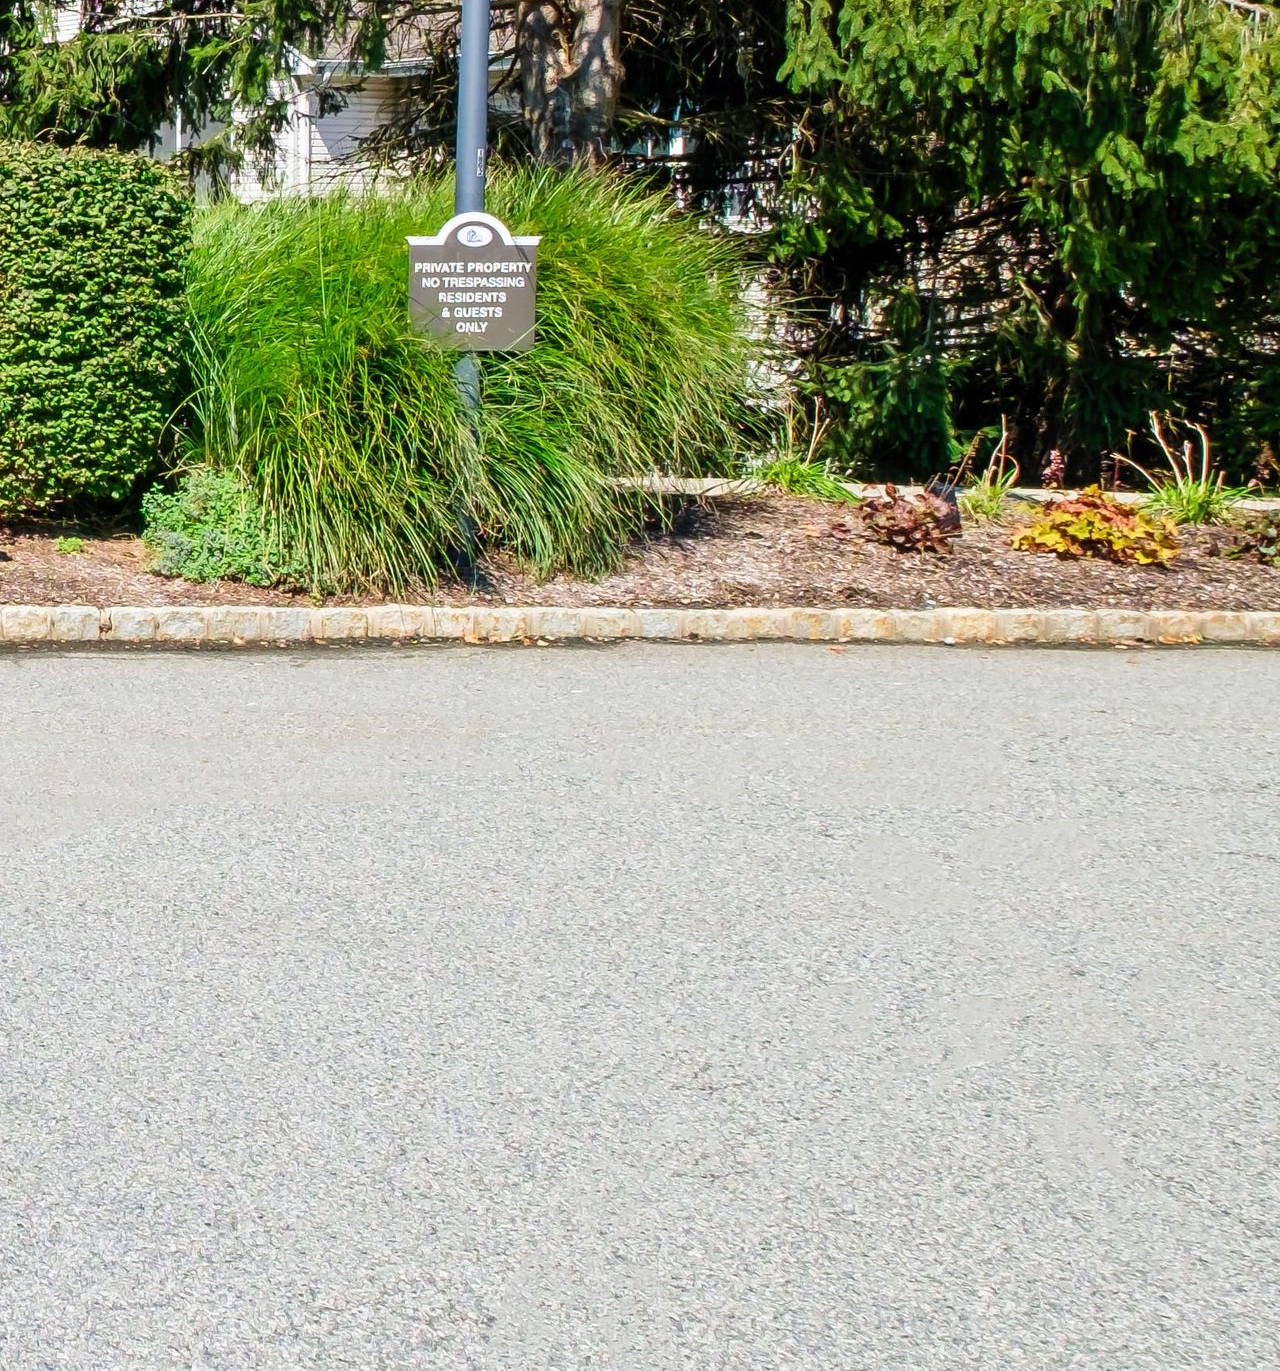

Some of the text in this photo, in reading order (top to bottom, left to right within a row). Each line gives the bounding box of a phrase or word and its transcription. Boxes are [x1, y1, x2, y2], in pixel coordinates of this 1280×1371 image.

[414, 262, 533, 273] PRIVATE PROPERTY
[421, 277, 525, 288] NO TRESPASSING
[438, 292, 507, 303] RESIDENTS
[442, 307, 502, 318] & GUESTS
[455, 322, 488, 333] ONLY
